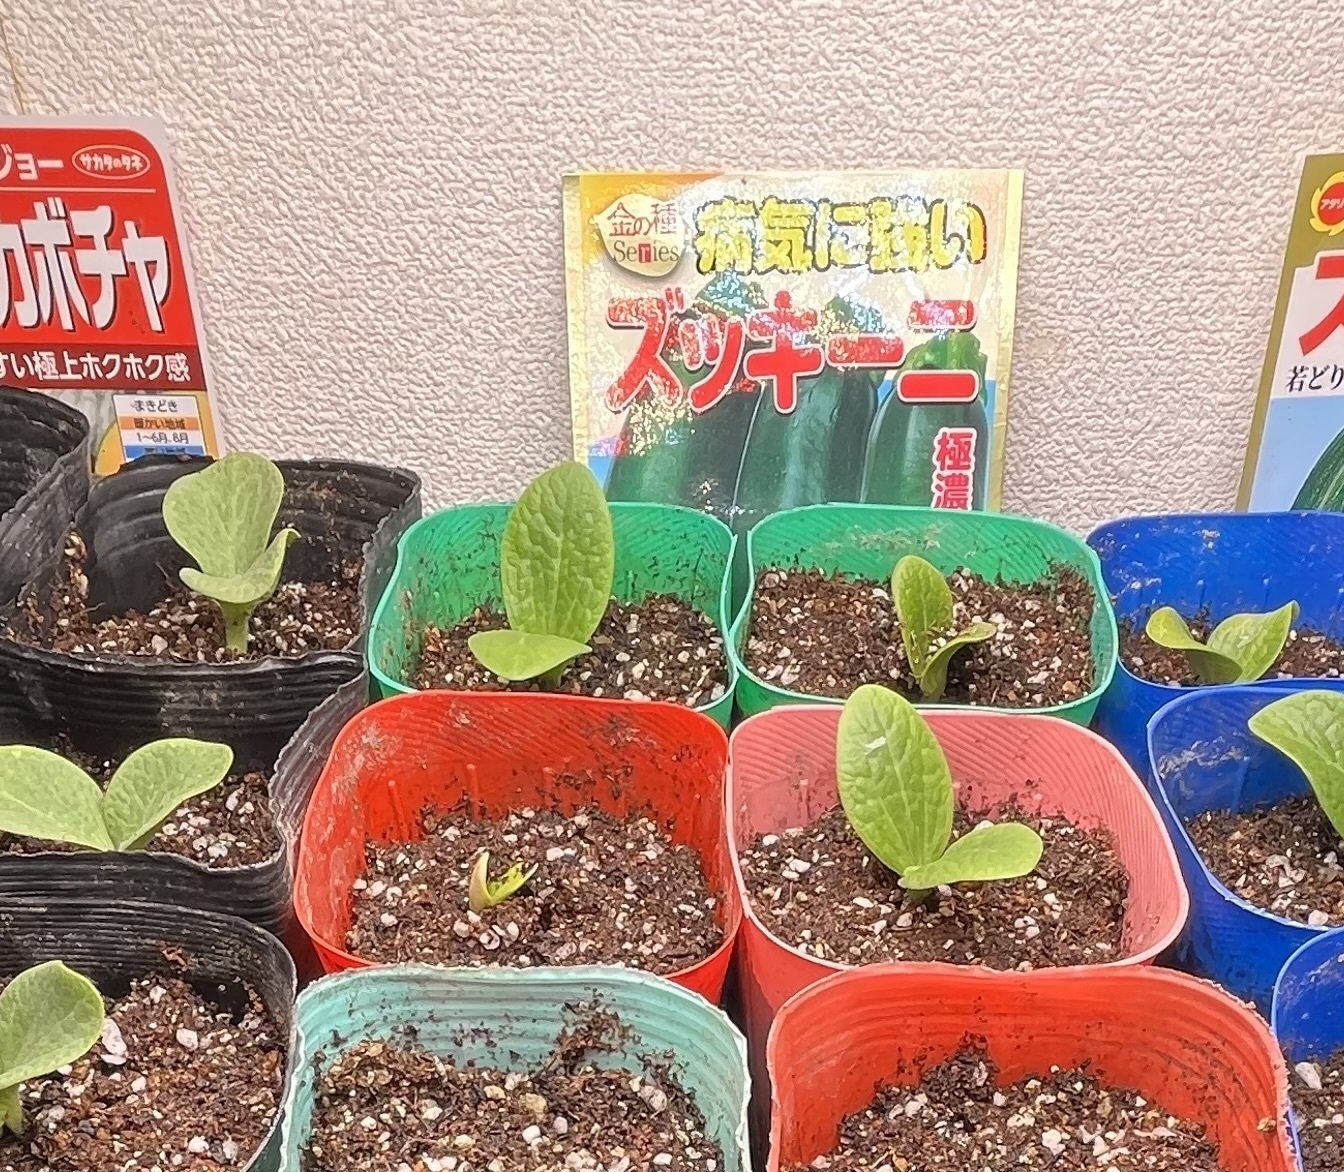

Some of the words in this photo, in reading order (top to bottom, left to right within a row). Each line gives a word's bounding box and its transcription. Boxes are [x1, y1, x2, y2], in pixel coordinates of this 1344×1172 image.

[79, 153, 144, 172] サカタのタネ
[606, 201, 677, 237] 金の種
[696, 195, 987, 274] 病気に強い
[613, 239, 680, 263] Series
[606, 287, 979, 416] ズッキーニ
[132, 399, 178, 412] まきどき
[934, 430, 974, 511] 極濃
